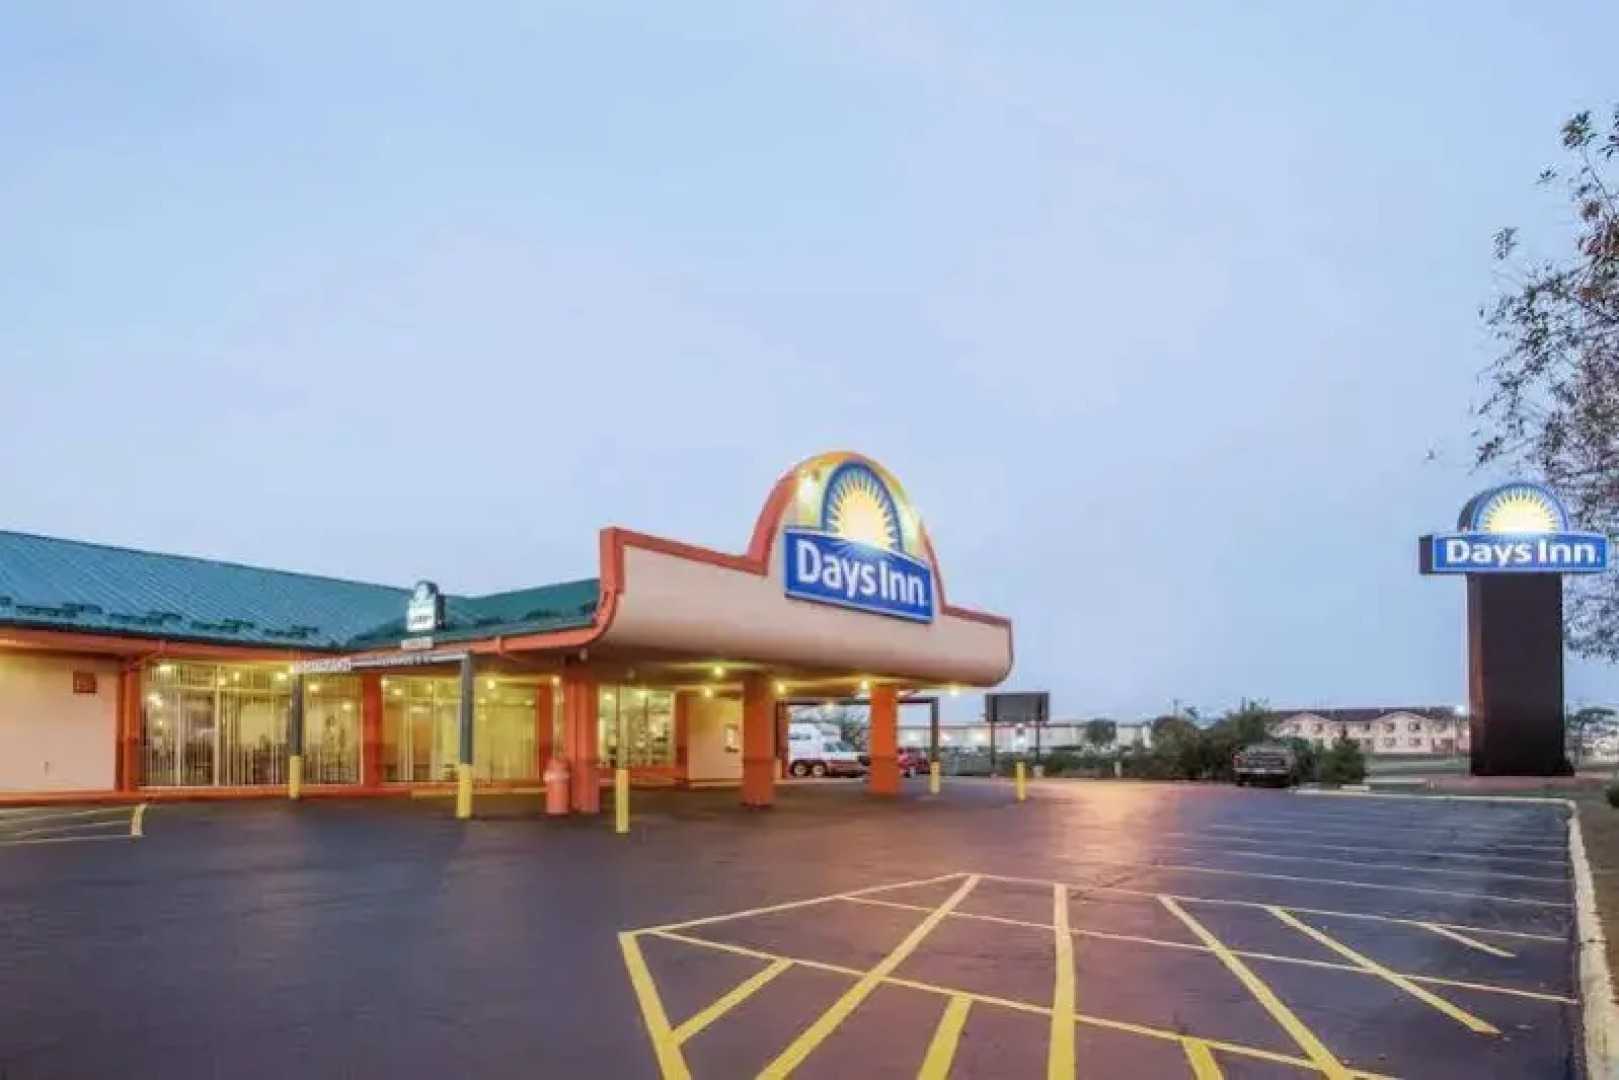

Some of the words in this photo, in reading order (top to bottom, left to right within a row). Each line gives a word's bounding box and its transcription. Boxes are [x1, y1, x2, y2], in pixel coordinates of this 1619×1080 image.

[796, 540, 876, 597] Days
[880, 560, 924, 605] Inn
[1446, 539, 1532, 567] Days
[1538, 538, 1595, 563] Inn
